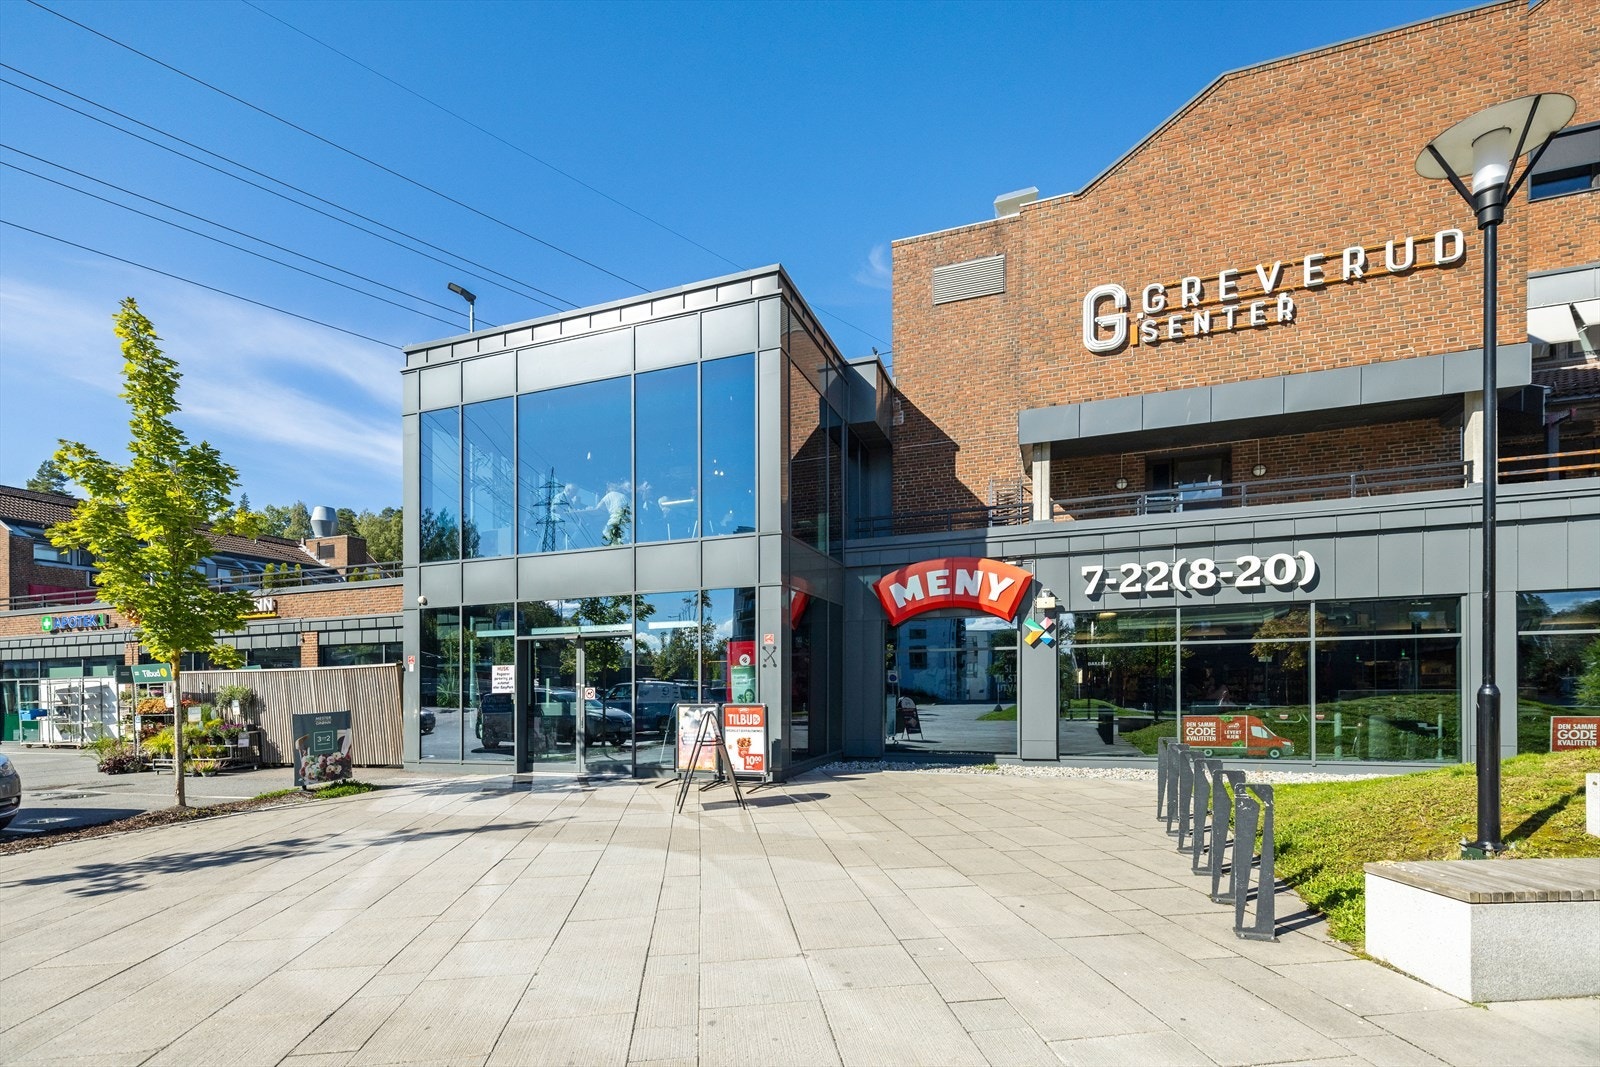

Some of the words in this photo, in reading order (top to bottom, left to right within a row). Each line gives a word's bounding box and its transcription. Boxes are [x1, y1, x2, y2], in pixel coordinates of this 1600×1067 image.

[1142, 228, 1464, 314] GREVERUD
[1141, 293, 1294, 343] SENTER
[889, 568, 1015, 608] MENY
[54, 614, 97, 628] APOTEK
[98, 613, 105, 626] 1
[142, 669, 161, 678] Tilbud
[728, 714, 761, 725] TILBUD
[1186, 727, 1216, 736] GODE
[1557, 730, 1597, 740] GODE
